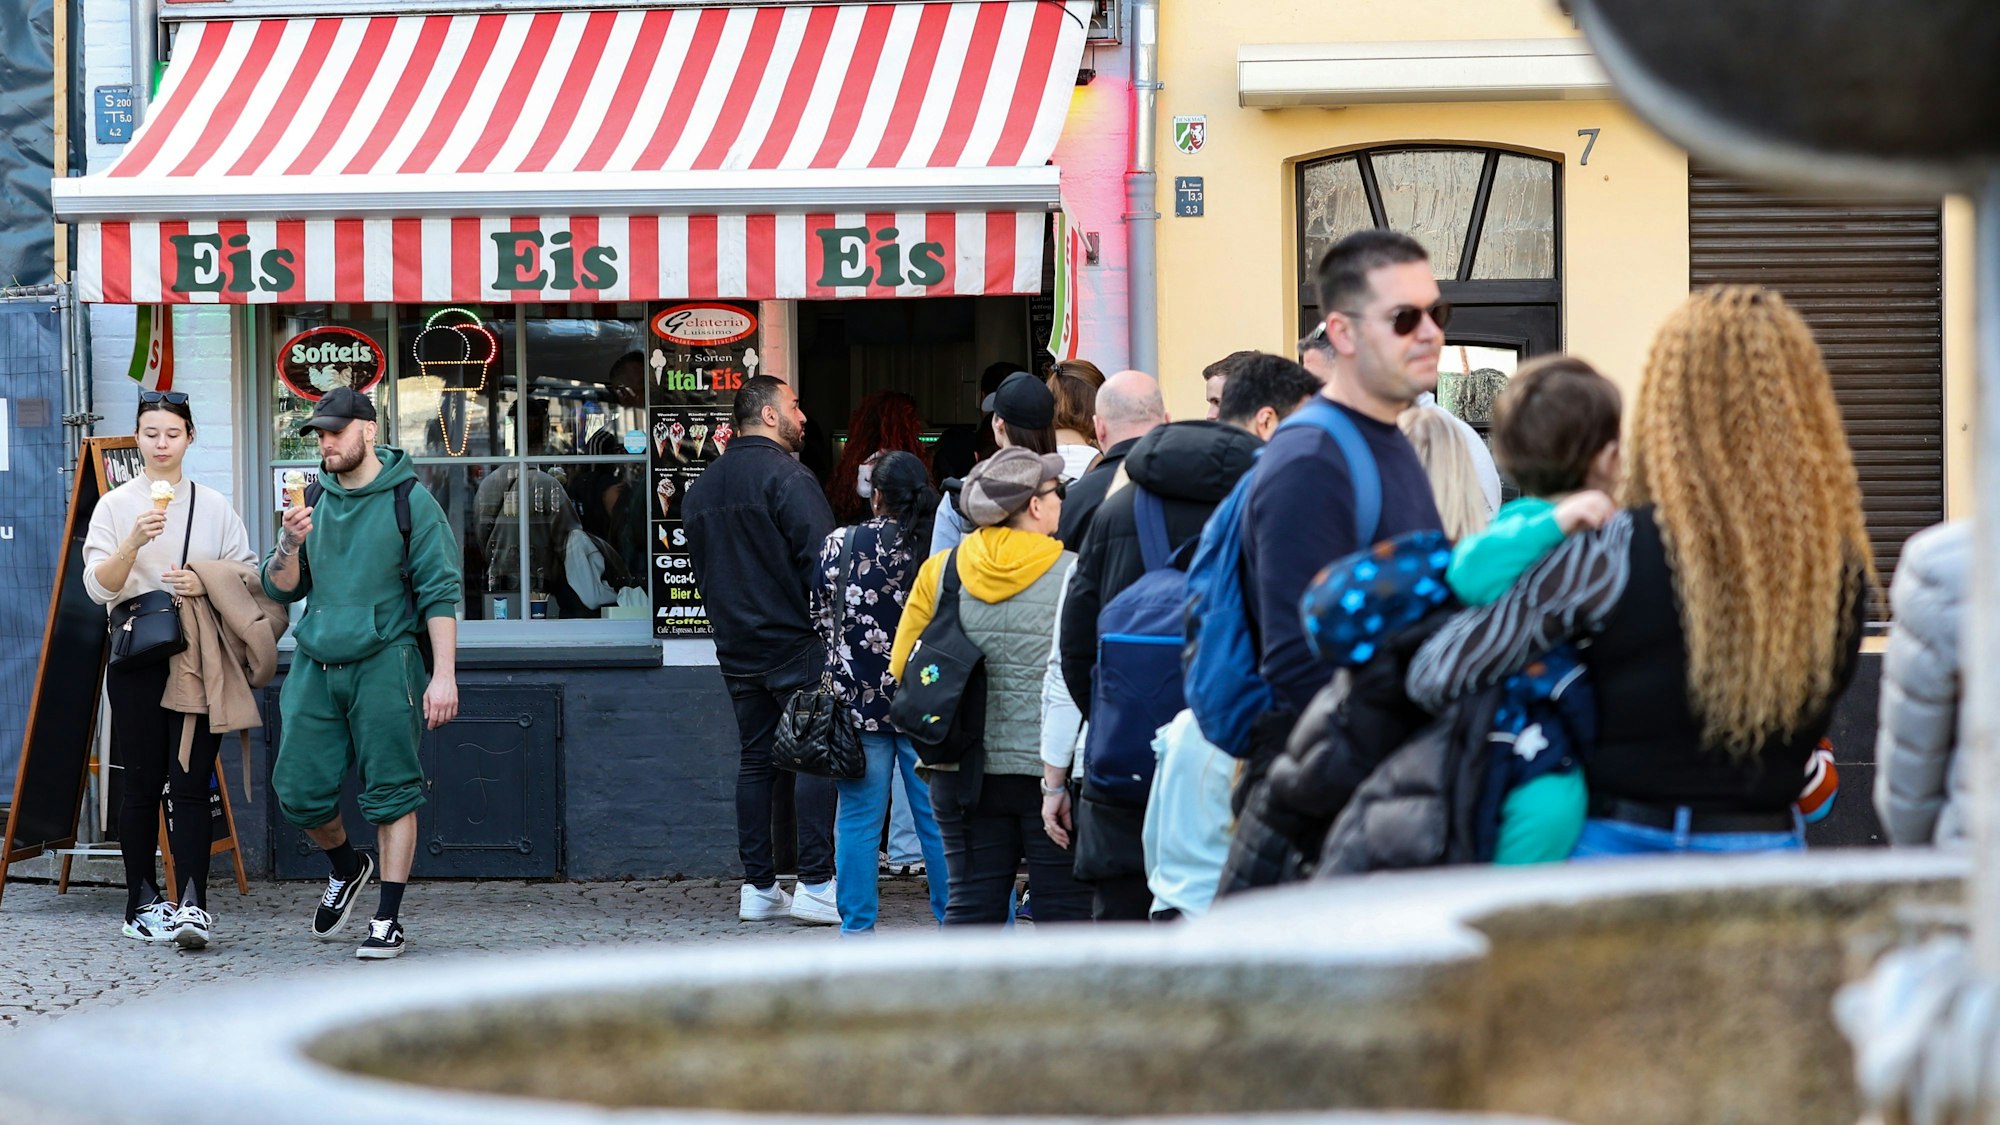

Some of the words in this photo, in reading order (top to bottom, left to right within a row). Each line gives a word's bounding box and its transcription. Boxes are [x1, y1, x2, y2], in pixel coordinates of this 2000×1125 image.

[105, 94, 114, 107] S
[116, 98, 132, 107] 200
[119, 114, 132, 123] 5.0
[109, 127, 122, 137] 4.2
[1577, 128, 1601, 166] 7
[1181, 180, 1187, 189] A
[1190, 192, 1203, 202] 3,3
[1185, 205, 1199, 215] 3,3
[169, 233, 296, 293] Eis
[491, 229, 619, 291] Eis
[815, 226, 946, 287] Eis
[665, 311, 743, 334] Gelateria
[291, 341, 373, 364] Softeis
[678, 354, 691, 363] 17
[695, 354, 733, 362] Sorten
[667, 367, 710, 391] Ital.
[711, 367, 743, 391] Eis
[664, 571, 696, 584] Coca-C
[670, 587, 691, 600] Bier
[656, 604, 707, 617] LAVA
